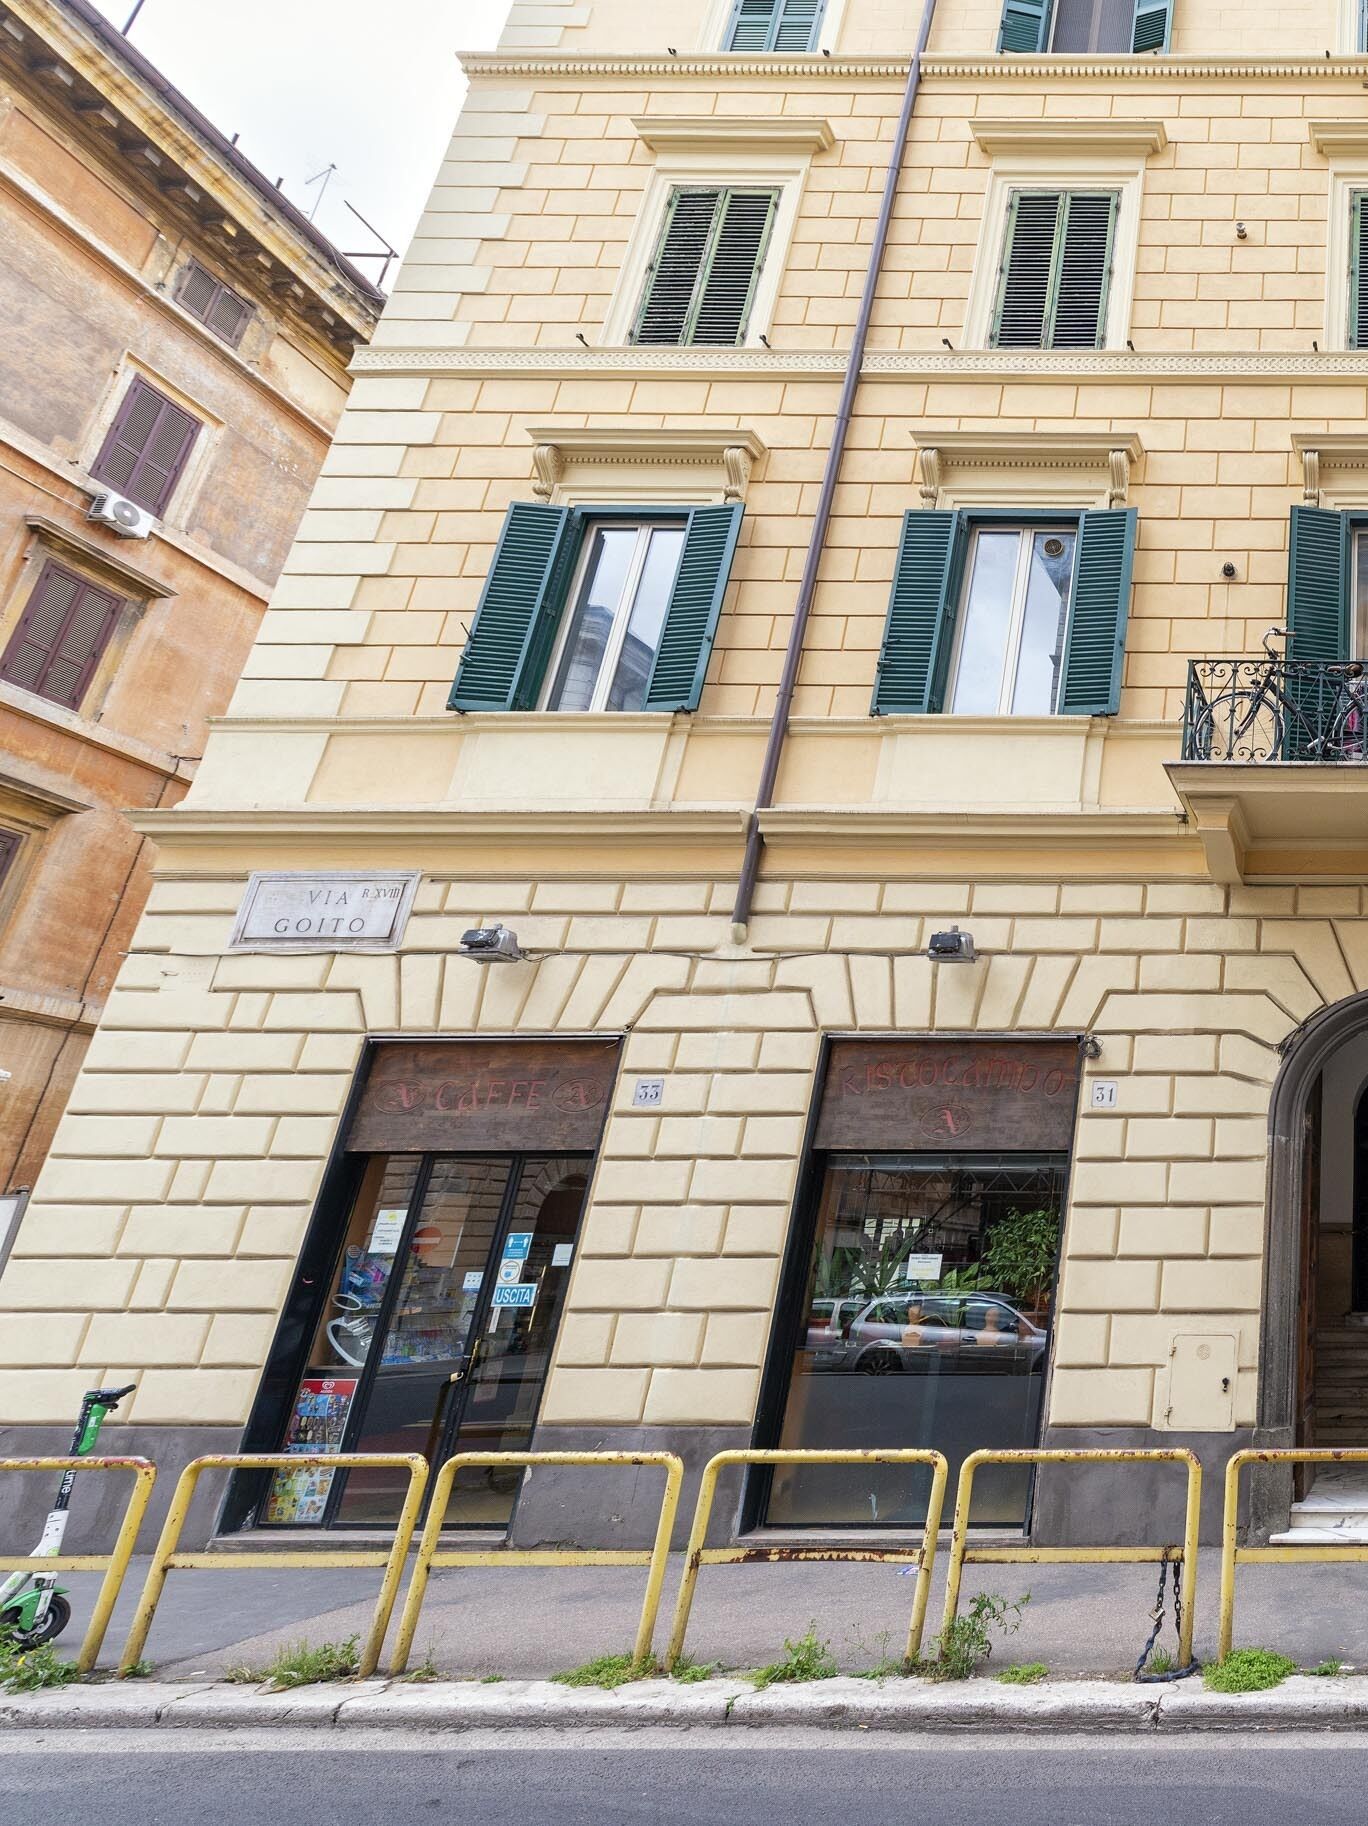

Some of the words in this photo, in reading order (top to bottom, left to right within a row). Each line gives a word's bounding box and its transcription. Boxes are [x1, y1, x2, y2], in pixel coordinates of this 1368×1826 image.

[309, 890, 348, 905] VIA
[274, 918, 365, 933] GOITO
[639, 1085, 660, 1100] 33
[1096, 1087, 1113, 1102] 31
[496, 1288, 530, 1303] USCITA
